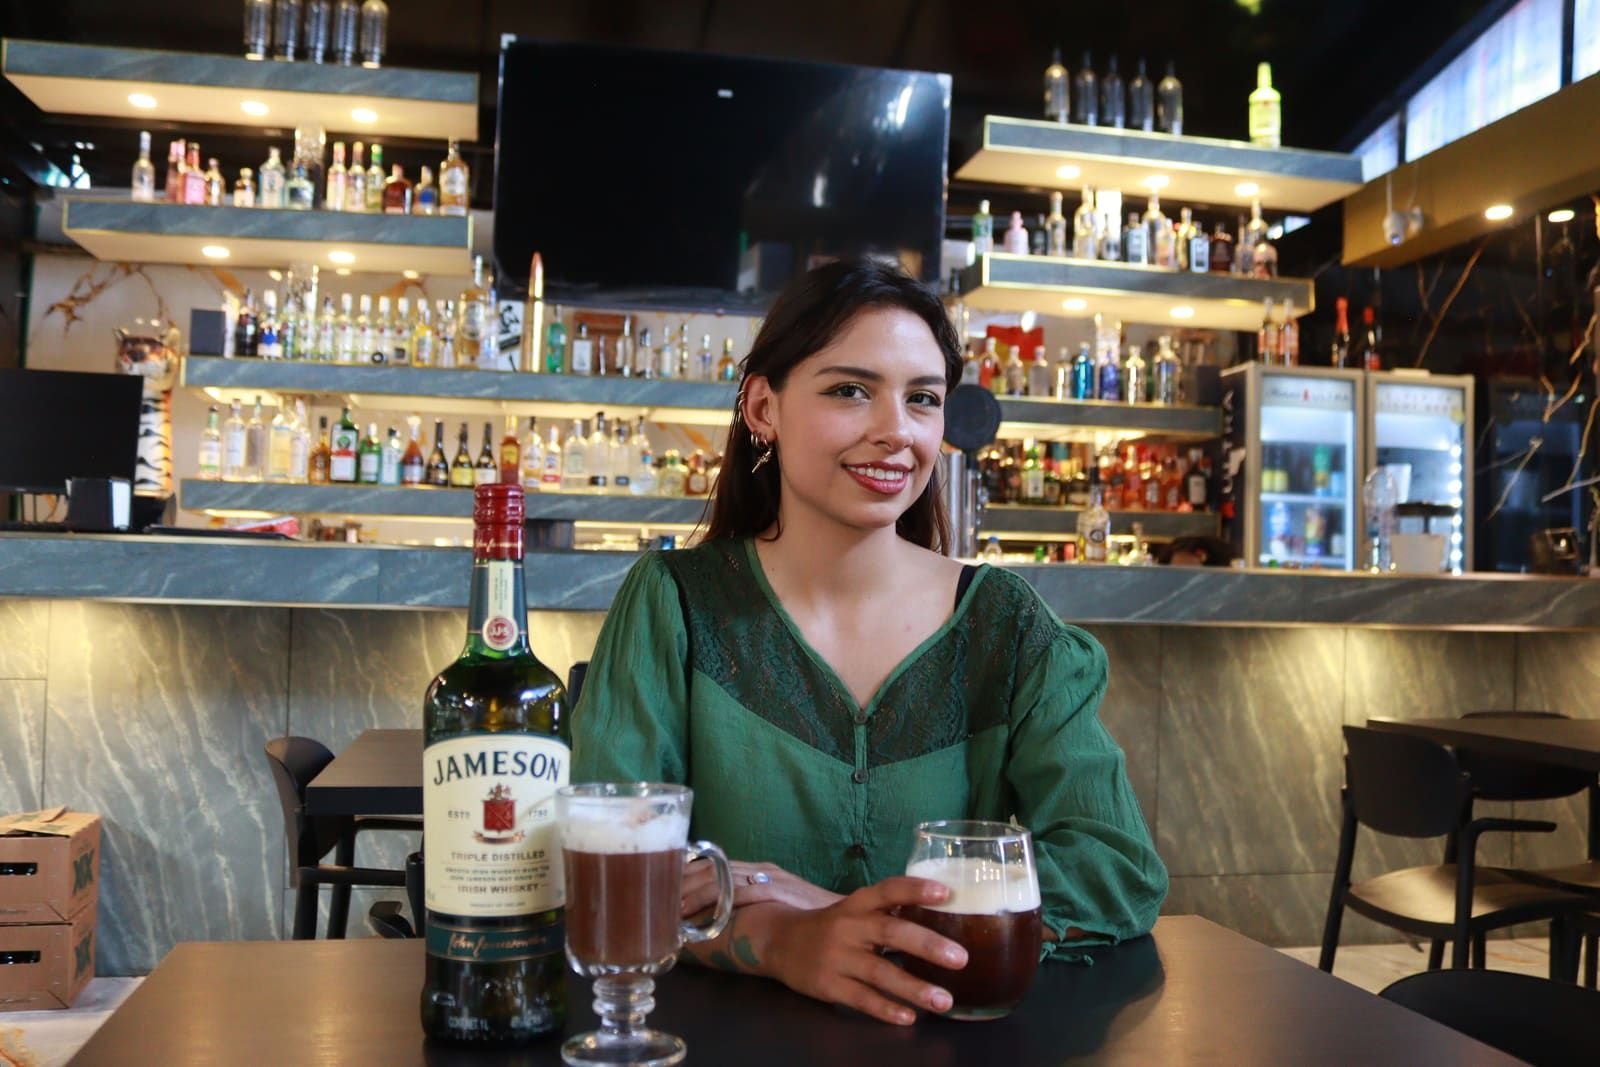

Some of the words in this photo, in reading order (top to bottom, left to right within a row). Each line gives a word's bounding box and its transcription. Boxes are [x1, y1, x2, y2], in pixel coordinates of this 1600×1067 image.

[435, 751, 560, 785] JAMESON
[451, 852, 488, 862] TRIPLE
[491, 850, 545, 862] DISTILLED
[457, 884, 487, 895] IRISH
[490, 883, 540, 895] WHISKEY
